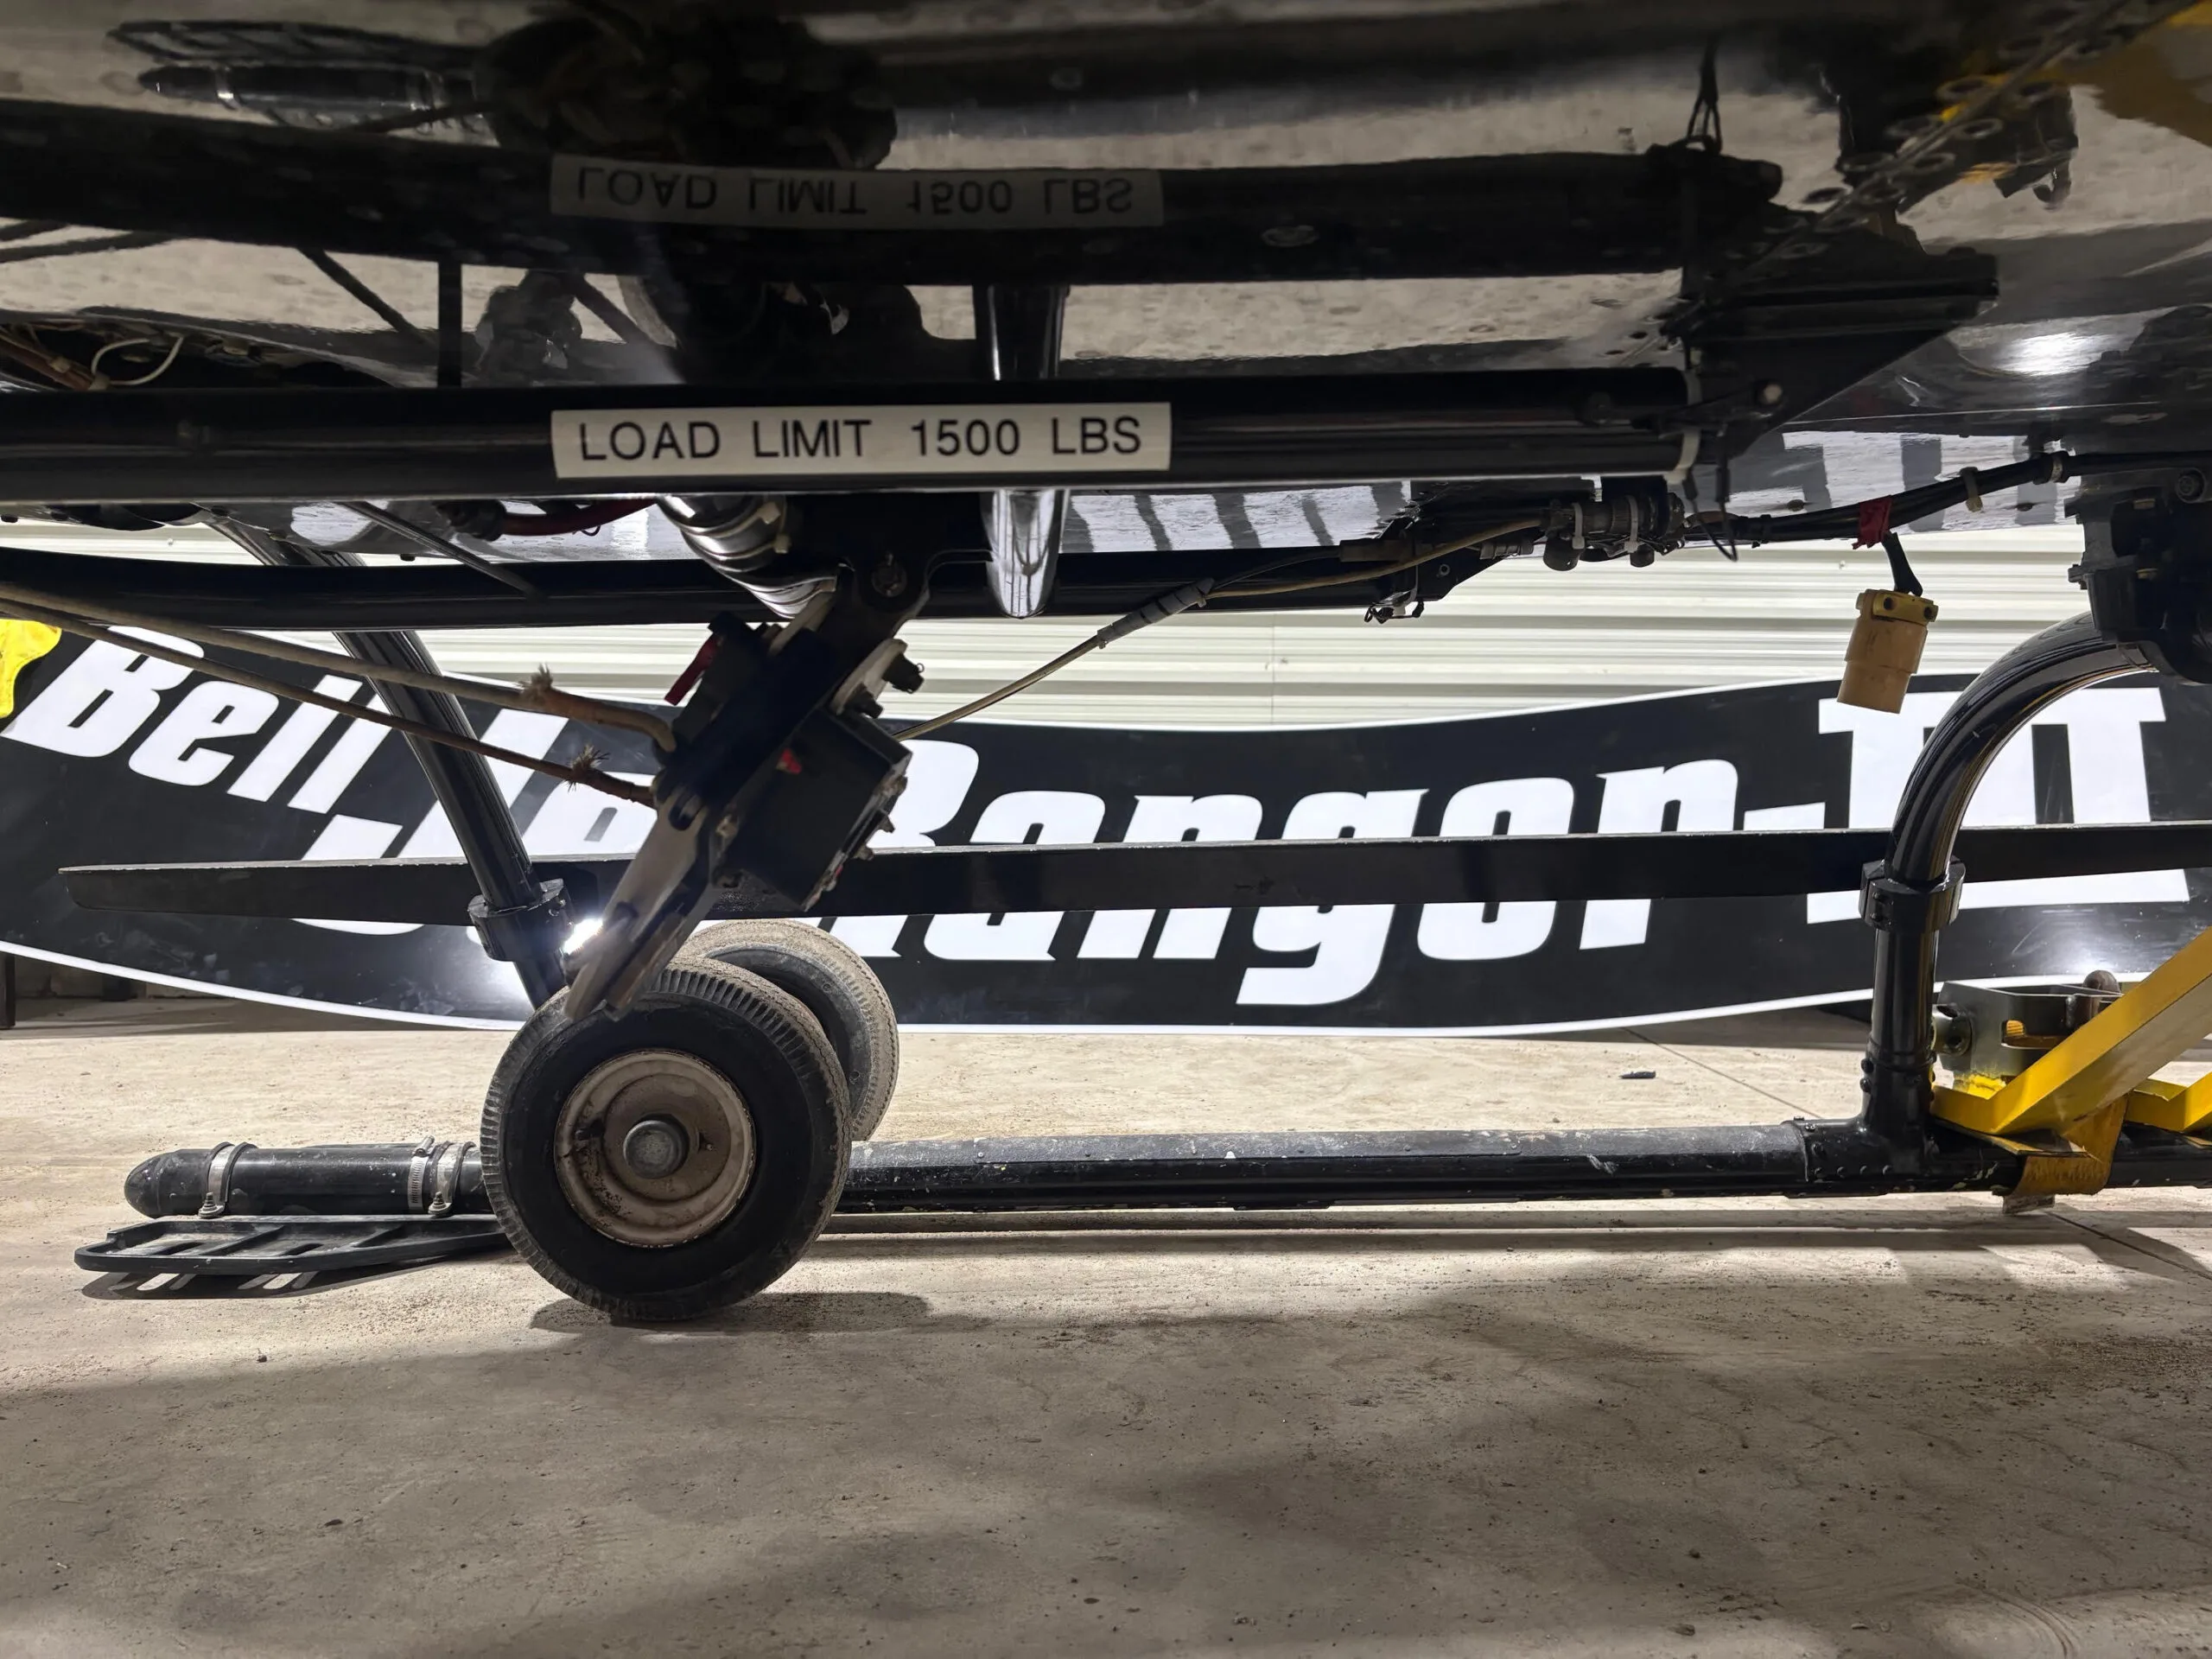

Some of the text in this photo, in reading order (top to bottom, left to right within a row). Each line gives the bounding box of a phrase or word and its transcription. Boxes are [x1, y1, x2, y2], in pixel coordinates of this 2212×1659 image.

[580, 416, 1141, 461] LOAD LIMIT 1500 LBS
[0, 626, 396, 814] Bell
